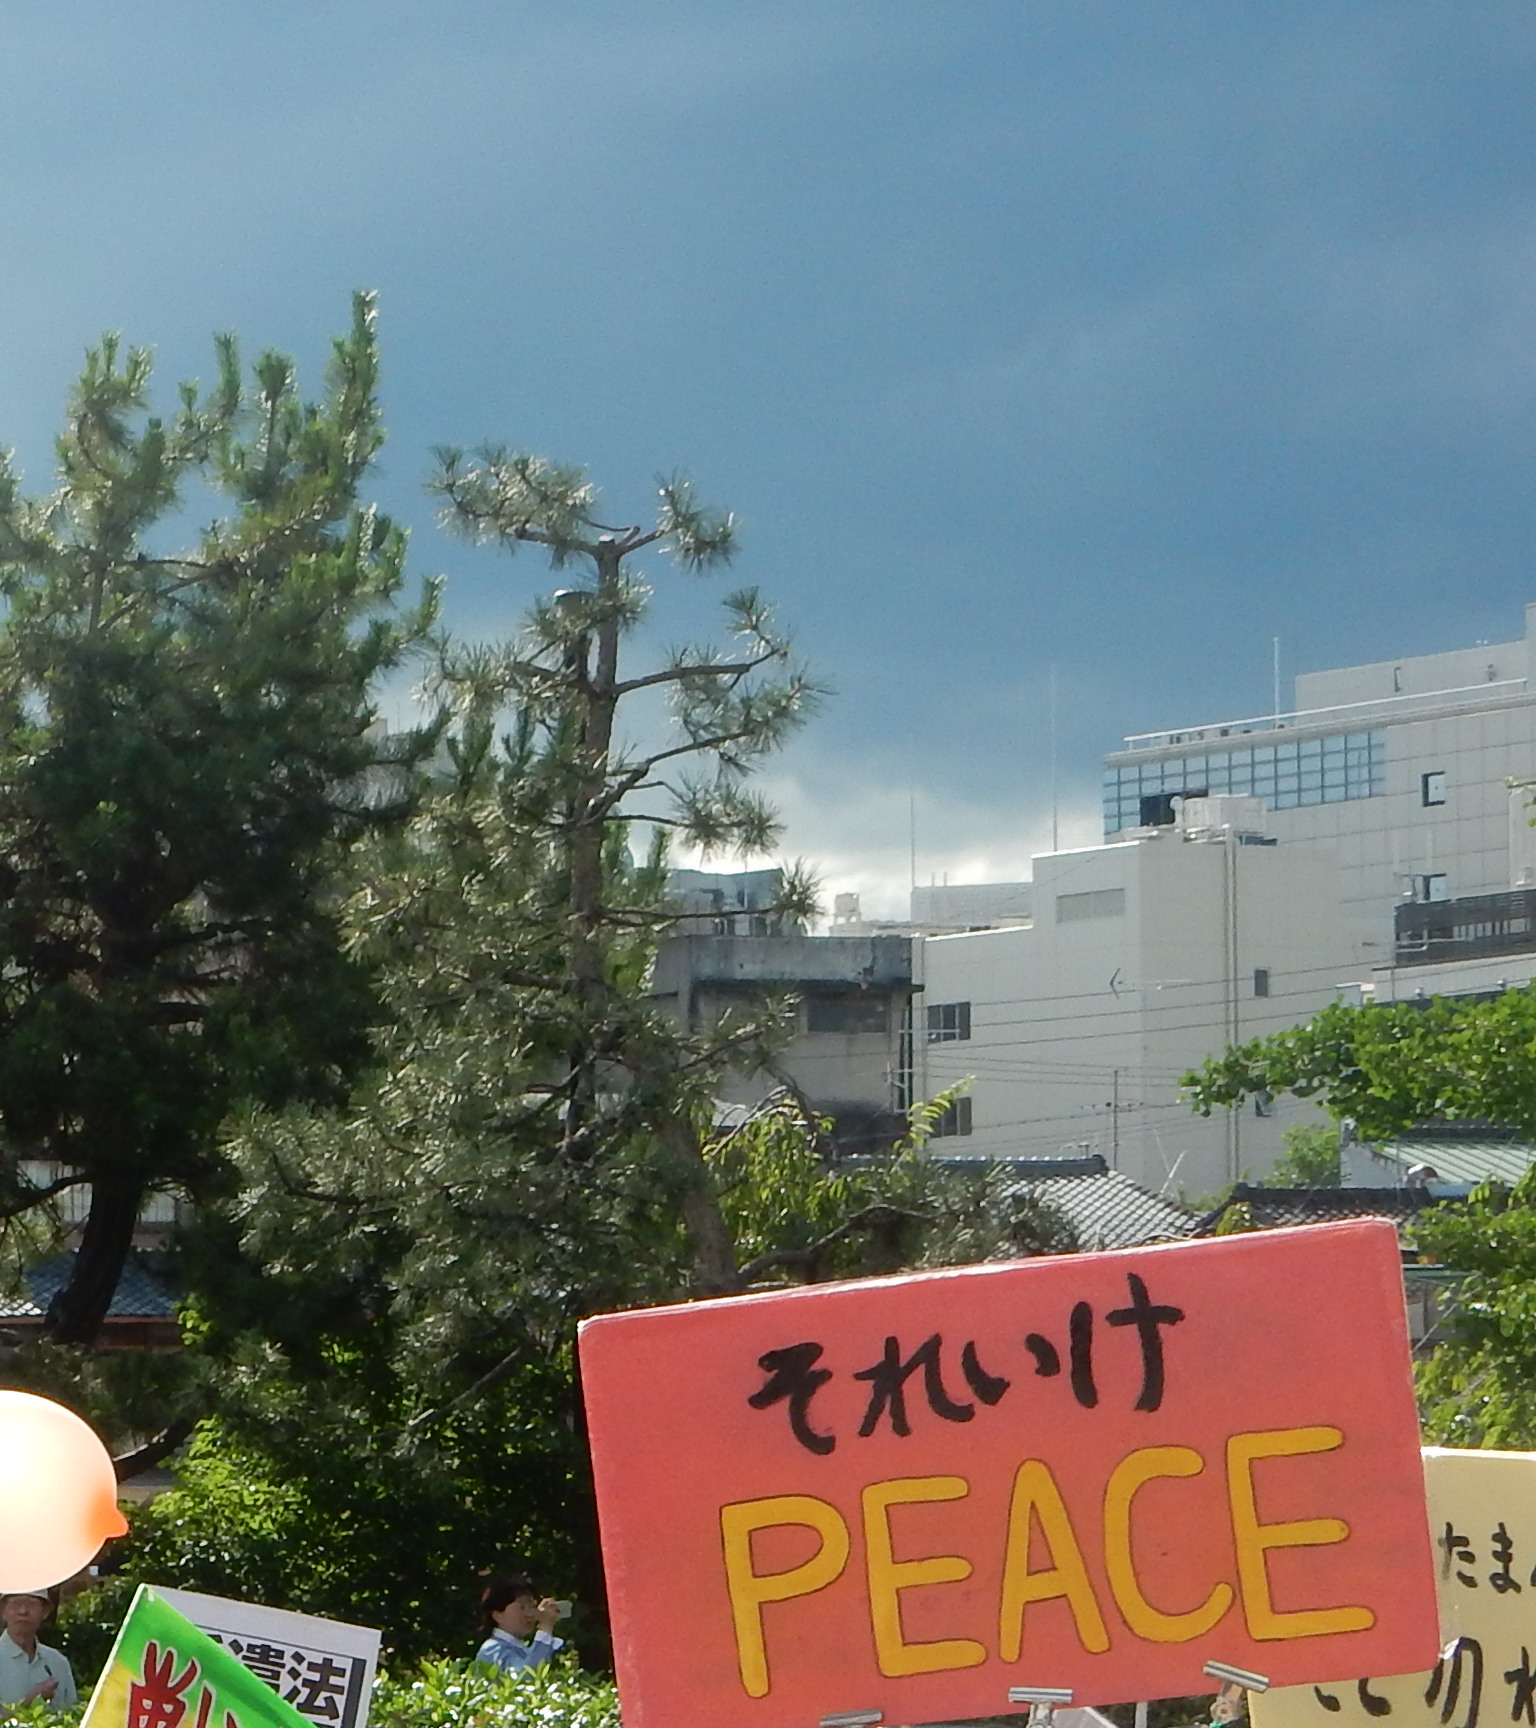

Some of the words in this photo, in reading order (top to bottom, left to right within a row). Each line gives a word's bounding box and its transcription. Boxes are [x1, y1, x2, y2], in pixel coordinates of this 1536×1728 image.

[747, 1273, 1184, 1455] それいけ
[718, 1425, 1377, 1699] PEACE
[1438, 1521, 1536, 1594] たま
